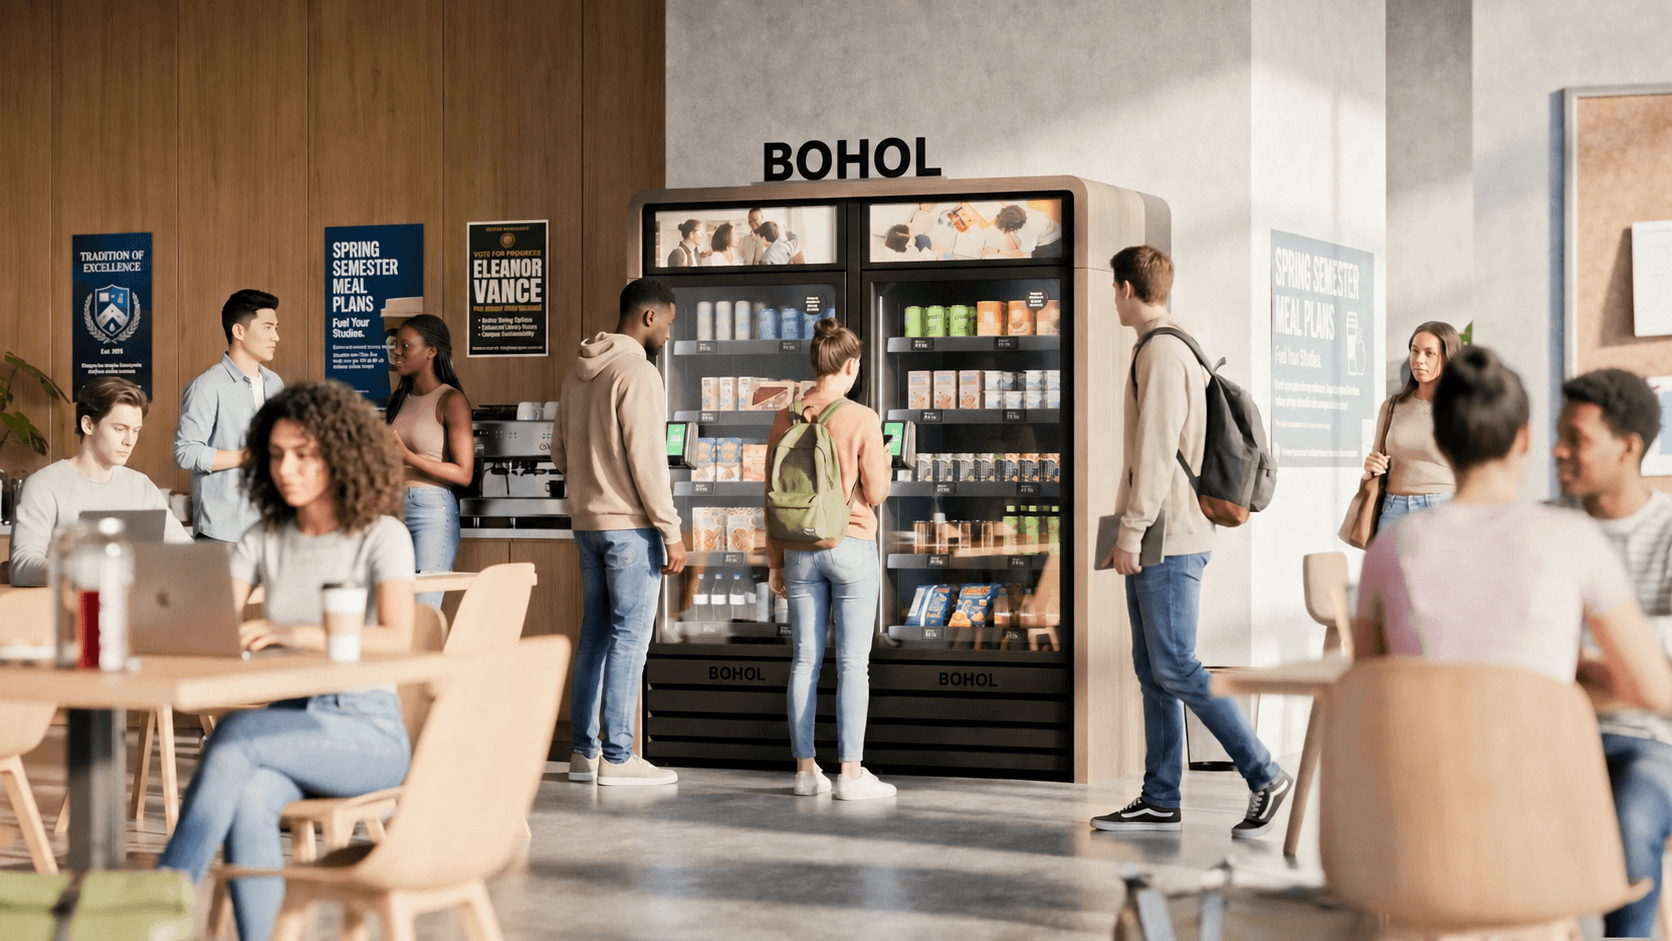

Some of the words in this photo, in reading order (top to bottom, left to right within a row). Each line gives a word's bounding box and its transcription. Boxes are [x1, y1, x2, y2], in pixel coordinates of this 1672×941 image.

[764, 137, 942, 181] BOHOL
[80, 250, 130, 262] TRADITION
[131, 250, 145, 261] OF
[332, 241, 380, 259] SPRING
[83, 262, 141, 273] EXCELLENCE
[332, 258, 399, 277] SEMESTER
[473, 258, 542, 278] ELEANOR
[1275, 246, 1312, 292] SPRING
[1312, 255, 1360, 300] SEMESTER
[332, 277, 368, 295] MEAL
[473, 278, 542, 304] VANCE
[332, 295, 374, 313] PLANS
[332, 317, 350, 328] Fuel
[351, 317, 370, 328] Your
[1275, 294, 1303, 336] MEAL
[1303, 299, 1336, 341] PLANS
[332, 328, 366, 339] Studies.
[709, 666, 766, 681] BOHOL
[939, 672, 998, 687] BOHOL
